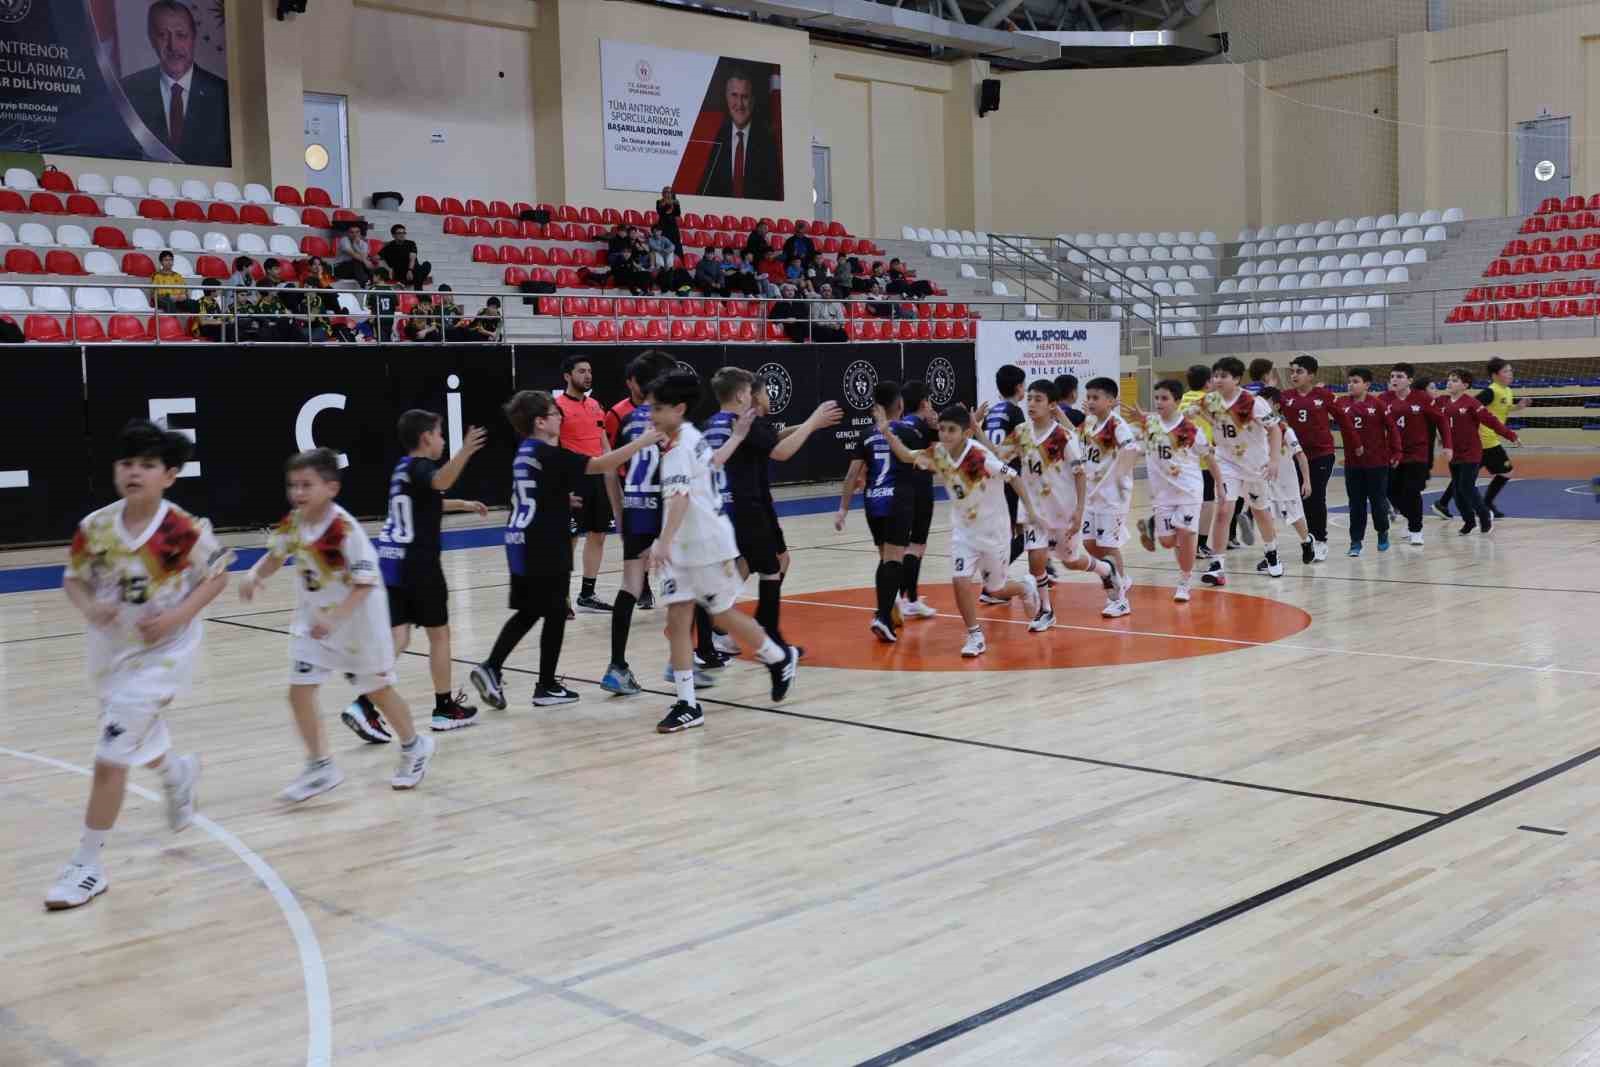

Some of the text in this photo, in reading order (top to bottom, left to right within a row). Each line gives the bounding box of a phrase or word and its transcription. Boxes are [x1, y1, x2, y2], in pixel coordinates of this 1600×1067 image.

[13, 76, 81, 94] DİLİYORUM
[1014, 329, 1041, 342] OKUL
[1298, 409, 1308, 422] 3
[1354, 416, 1364, 429] 2
[1222, 424, 1237, 438] 18
[1087, 447, 1100, 464] 12
[1158, 445, 1172, 460] 16
[874, 452, 891, 487] 7
[1028, 459, 1043, 476] 14
